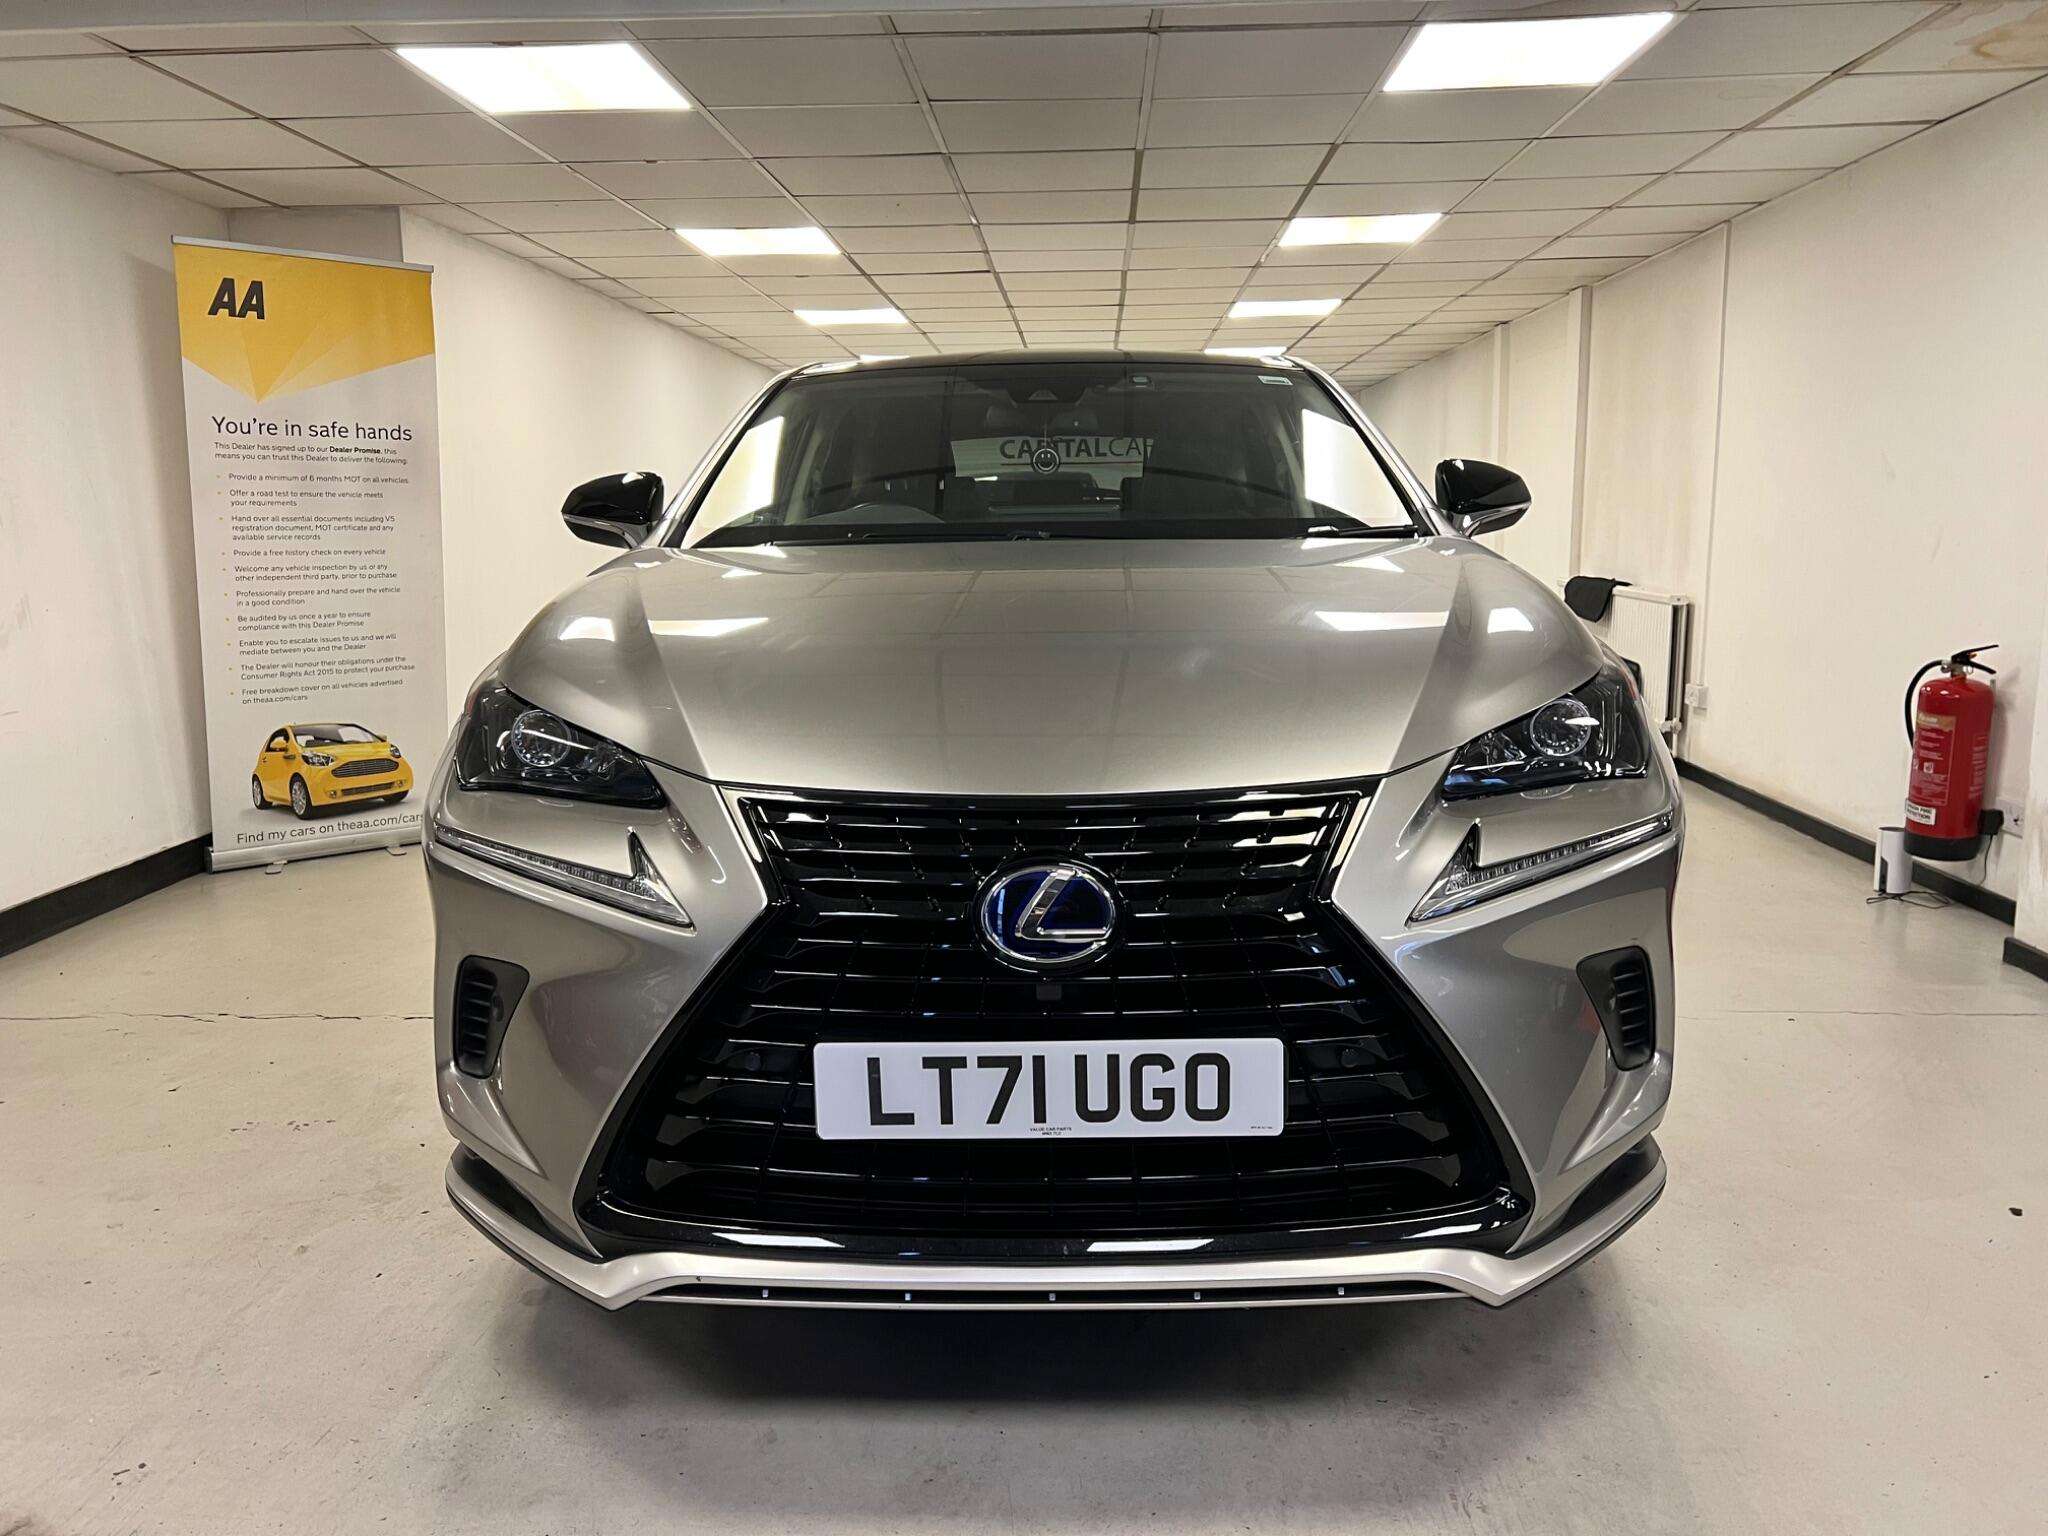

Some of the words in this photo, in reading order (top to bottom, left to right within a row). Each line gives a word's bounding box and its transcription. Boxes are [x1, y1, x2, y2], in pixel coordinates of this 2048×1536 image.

[207, 277, 265, 320] AA
[212, 416, 278, 436] You're
[285, 419, 302, 436] in
[308, 422, 349, 438] safe
[356, 422, 413, 441] hands
[231, 442, 255, 450] Dealer
[256, 443, 270, 451] has
[271, 444, 295, 453] signed
[305, 454, 328, 462] Dealer
[229, 473, 256, 481] Provide
[264, 474, 299, 482] minimum
[230, 489, 247, 497] Offer
[231, 500, 246, 508] your
[248, 499, 297, 508] requirements
[353, 516, 384, 524] including
[232, 524, 273, 533] registration
[381, 525, 394, 533] any
[284, 549, 309, 557] history
[311, 564, 347, 573] inspection
[348, 564, 357, 572] by
[255, 574, 301, 582] independent
[341, 573, 357, 581] prior
[236, 590, 286, 598] Professionally
[251, 599, 270, 607] good
[248, 614, 276, 622] audited
[277, 614, 287, 622] by
[323, 613, 337, 621] year
[238, 623, 279, 633] compliance
[336, 620, 364, 628] Promise
[240, 639, 263, 647] Enable
[264, 639, 278, 647] you
[240, 648, 268, 656] mediate
[270, 646, 301, 654] between
[302, 646, 315, 654] you
[294, 660, 319, 668] honour
[320, 659, 335, 667] their
[337, 657, 375, 667] obligations
[375, 656, 393, 664] under
[241, 672, 277, 680] Consumer
[279, 670, 302, 679] Rights
[317, 668, 334, 676] 2015
[343, 666, 368, 676] protect
[369, 666, 383, 674] your
[384, 664, 415, 673] purchase
[259, 685, 299, 694] breakdown
[340, 681, 368, 689] vehicles
[369, 679, 402, 687] advertised
[237, 832, 264, 844] Find
[268, 830, 285, 842] my
[290, 827, 316, 837] cars
[319, 825, 334, 834] on
[867, 1054, 1047, 1125] LT71
[1074, 1052, 1230, 1123] UGO
